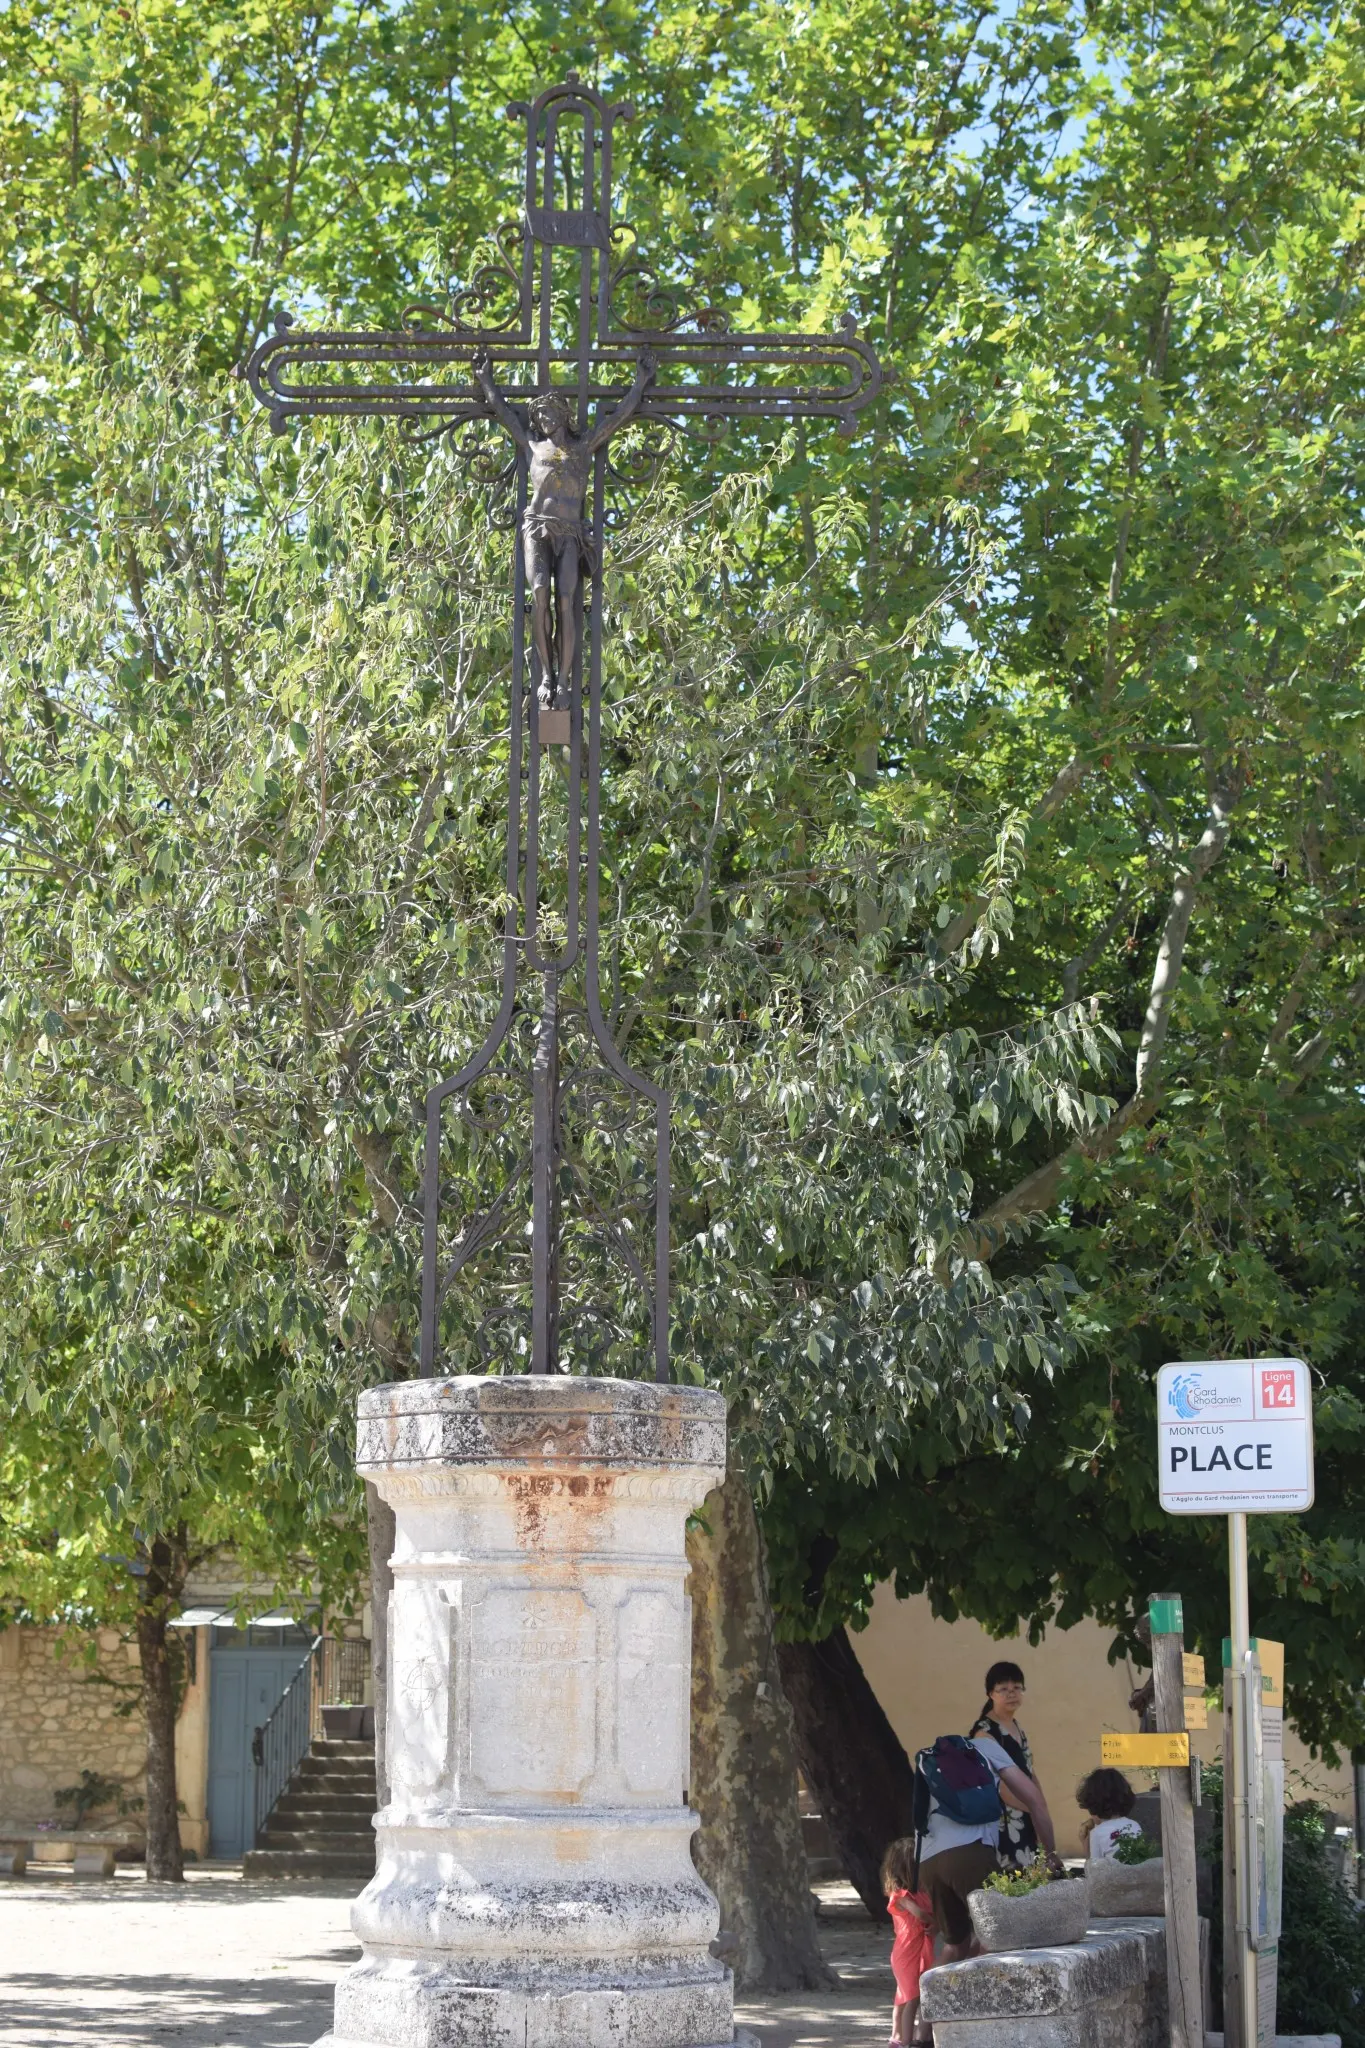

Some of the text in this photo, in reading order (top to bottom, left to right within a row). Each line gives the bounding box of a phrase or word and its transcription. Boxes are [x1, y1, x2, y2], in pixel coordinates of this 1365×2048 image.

[540, 214, 589, 241] INRI
[1265, 1373, 1291, 1383] Ligne
[1193, 1387, 1217, 1396] Gard
[1264, 1384, 1293, 1406] 14
[1193, 1396, 1242, 1405] Rhodanien
[1169, 1426, 1224, 1436] MONTCLUS
[1170, 1444, 1273, 1473] PLACE
[1267, 1493, 1299, 1501] transporte
